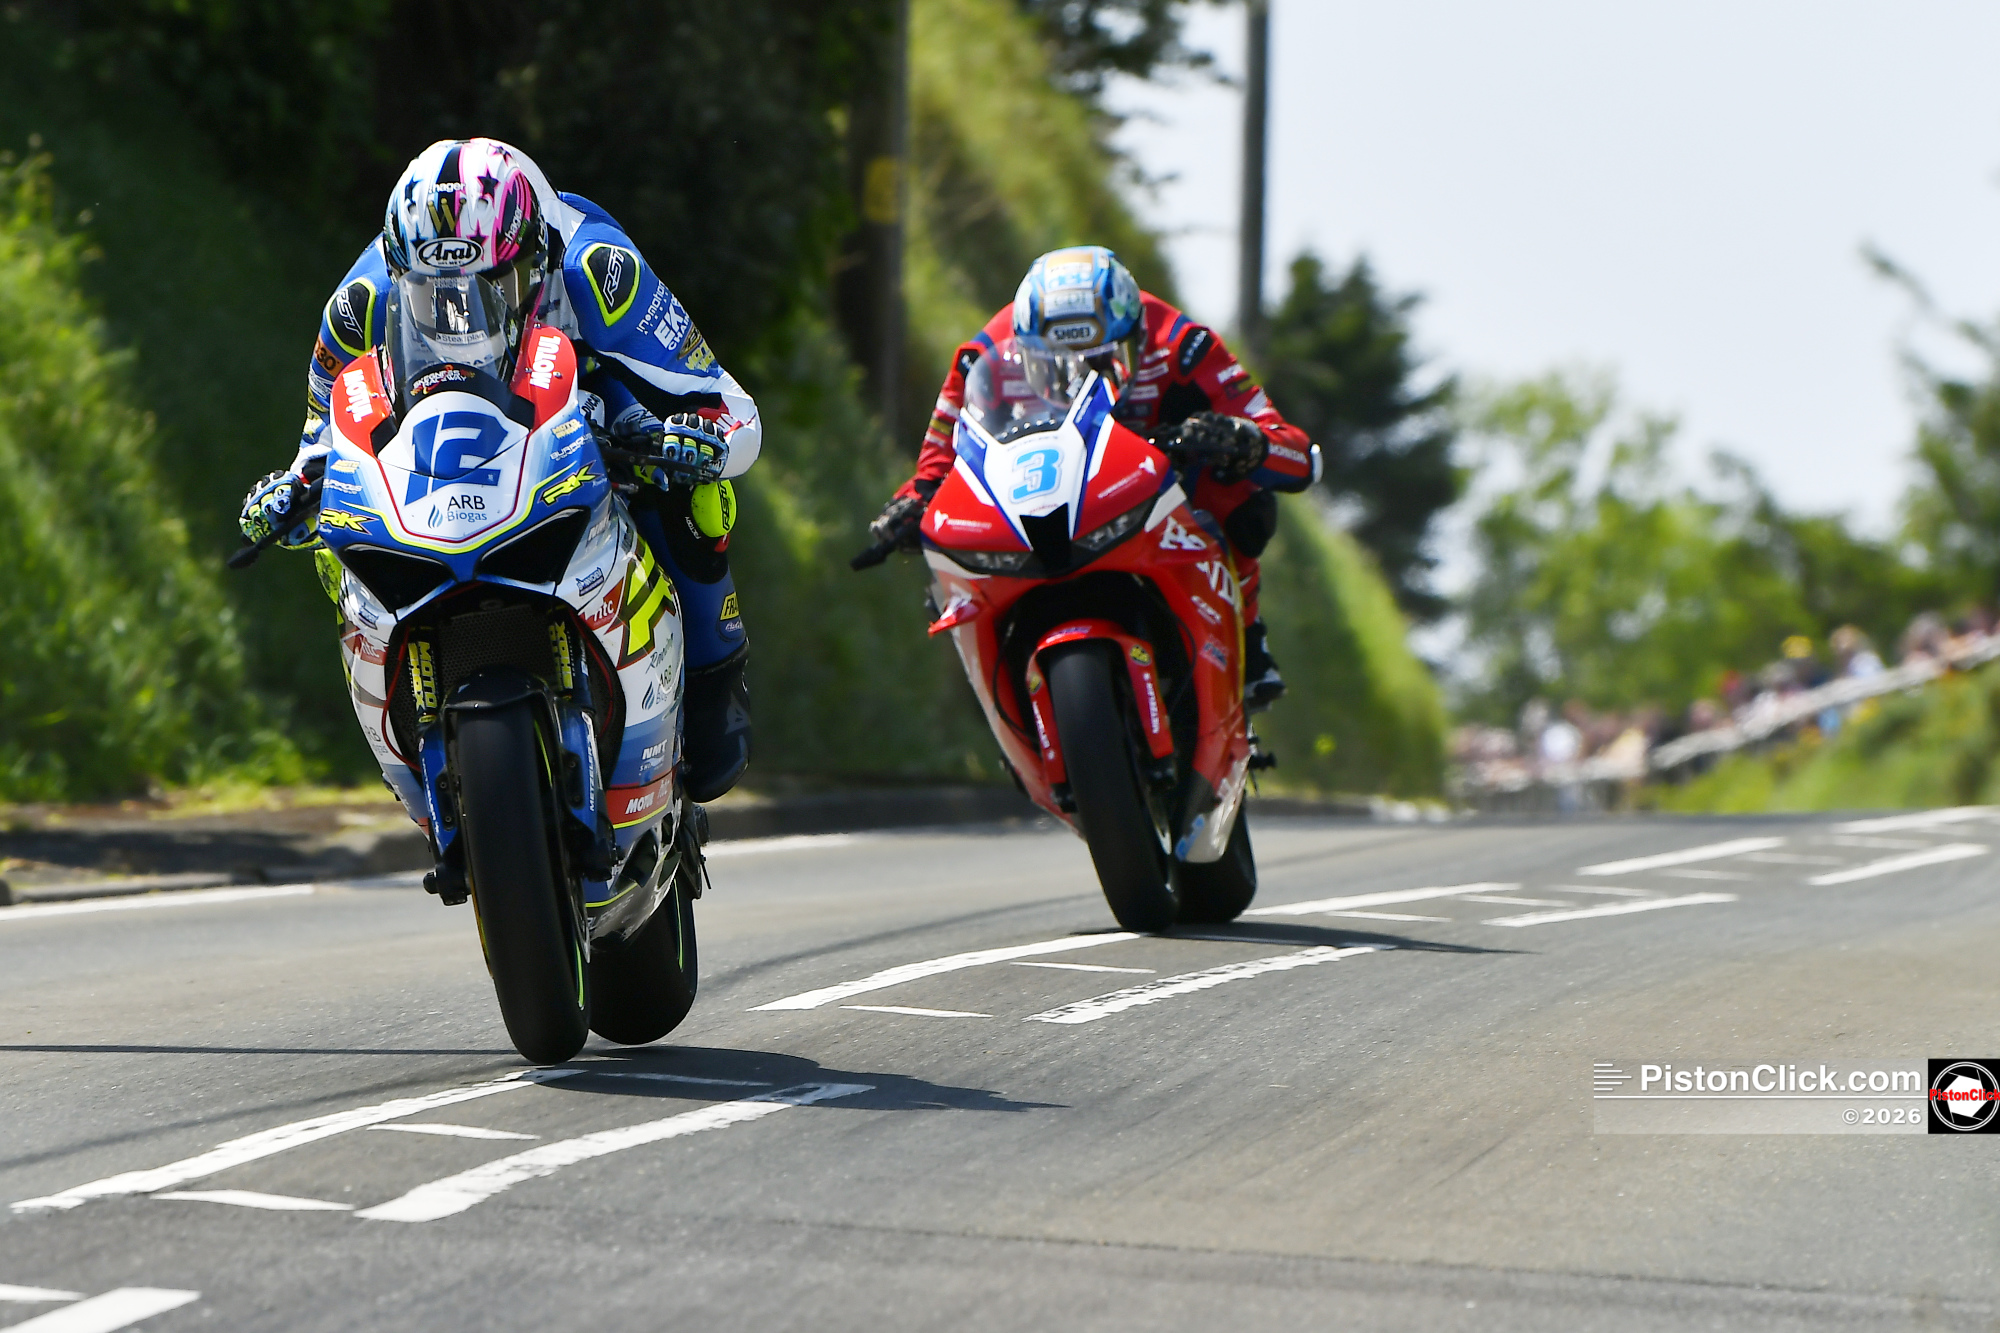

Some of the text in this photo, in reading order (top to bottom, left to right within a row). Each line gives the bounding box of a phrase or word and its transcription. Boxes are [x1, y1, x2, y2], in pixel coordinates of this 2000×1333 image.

[603, 248, 625, 307] RST
[336, 289, 363, 340] RST
[530, 335, 561, 390] MOTUL
[342, 369, 373, 423] MOTUL
[404, 411, 509, 506] 12
[1010, 449, 1060, 500] 3
[448, 495, 486, 511] ARB
[541, 465, 598, 504] RK
[447, 511, 488, 523] Biogas
